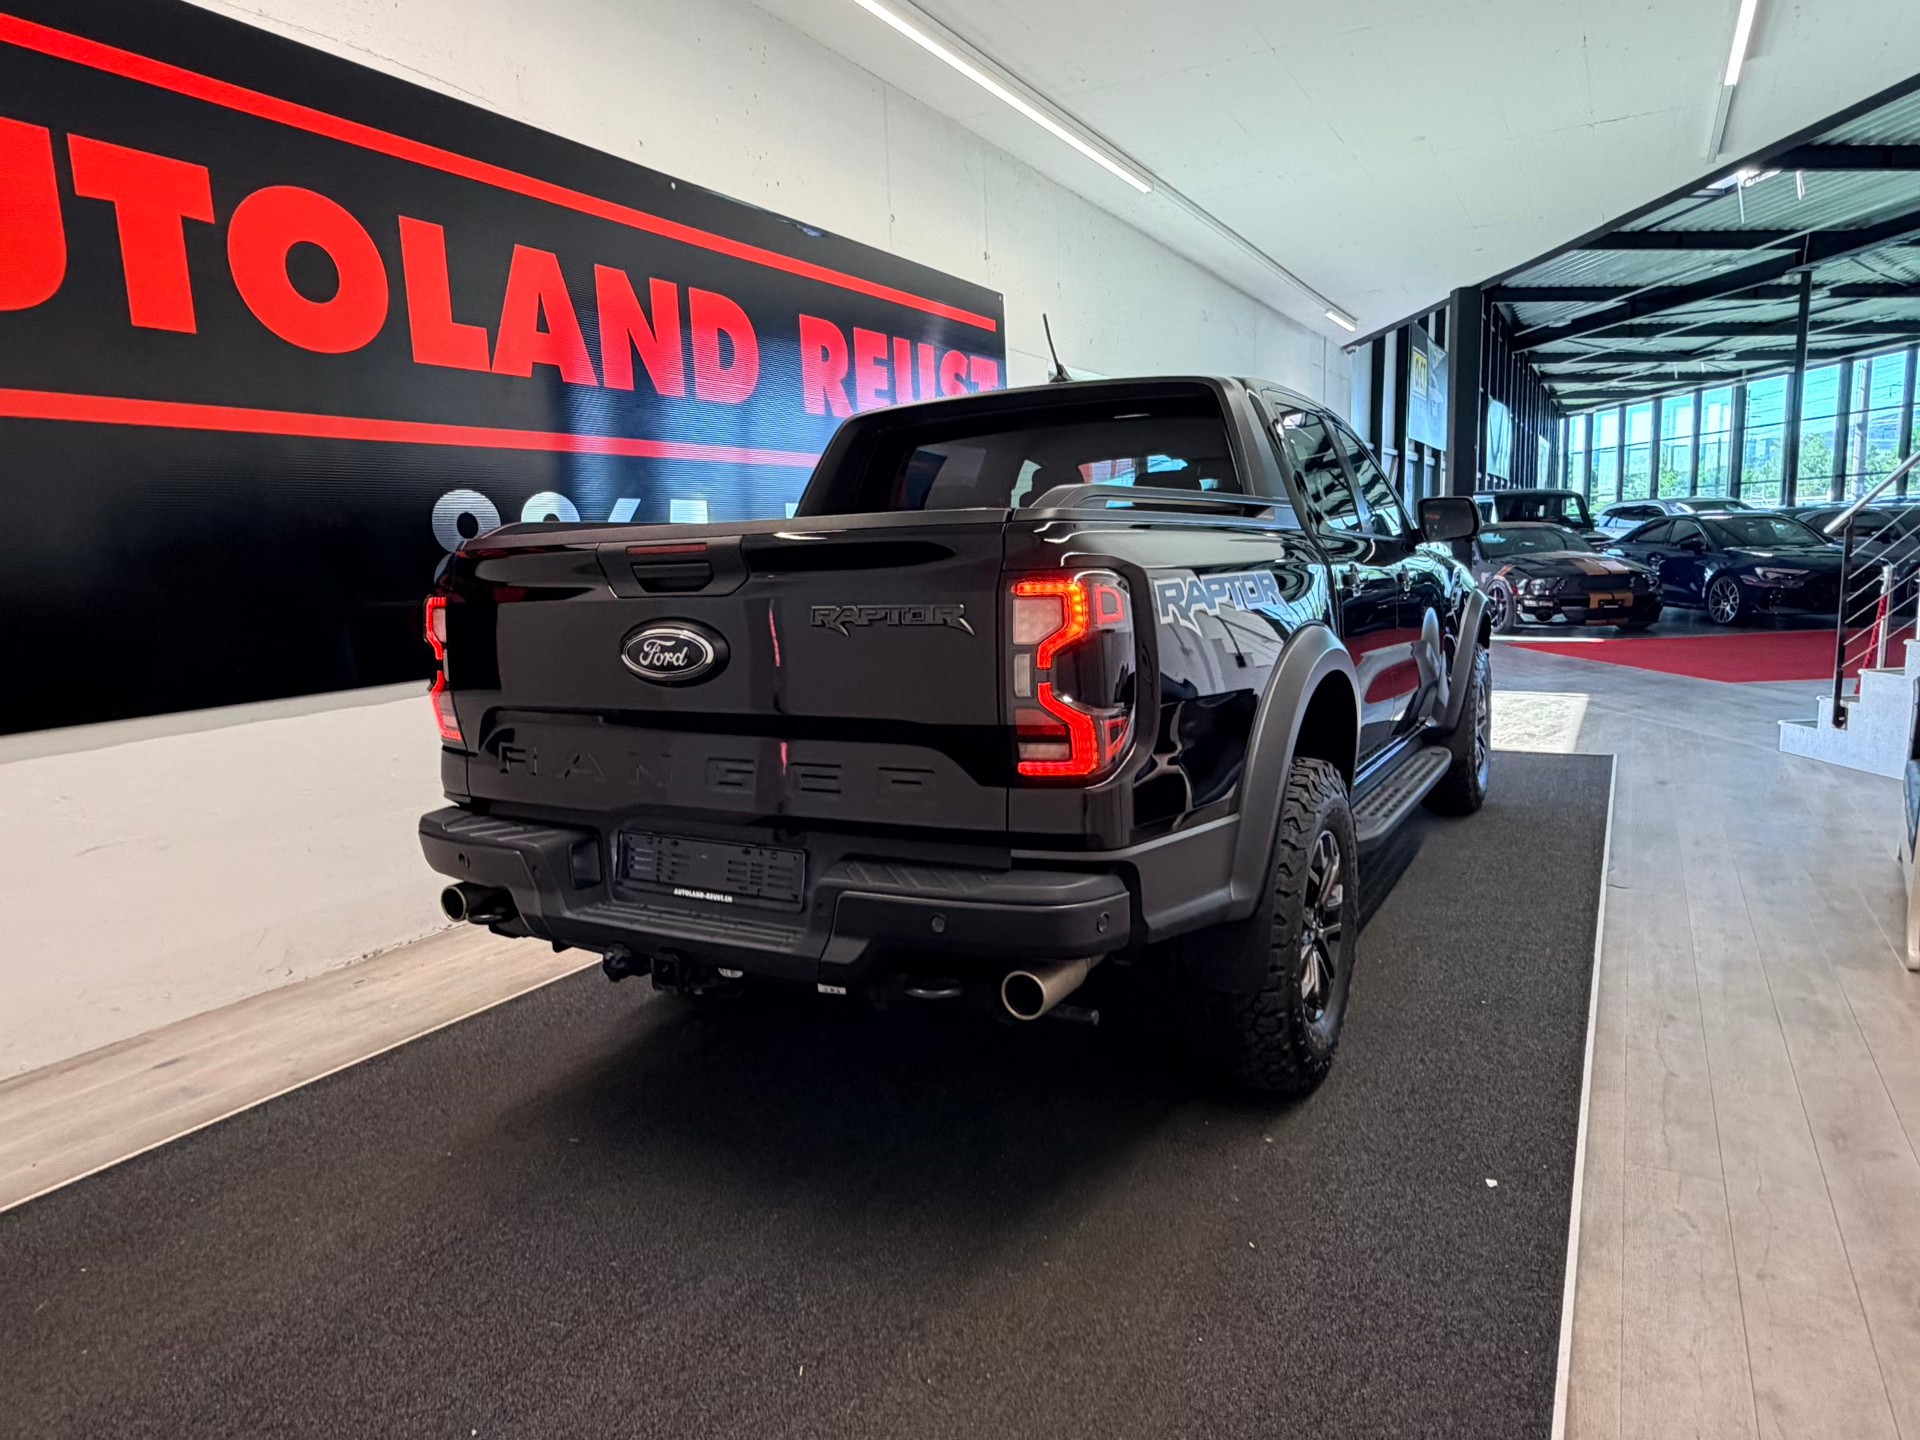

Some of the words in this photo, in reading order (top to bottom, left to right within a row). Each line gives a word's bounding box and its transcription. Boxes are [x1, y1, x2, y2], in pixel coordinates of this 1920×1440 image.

[811, 604, 976, 637] RAPTOR
[1154, 570, 1296, 638] RAPTOR
[639, 639, 689, 667] Ford
